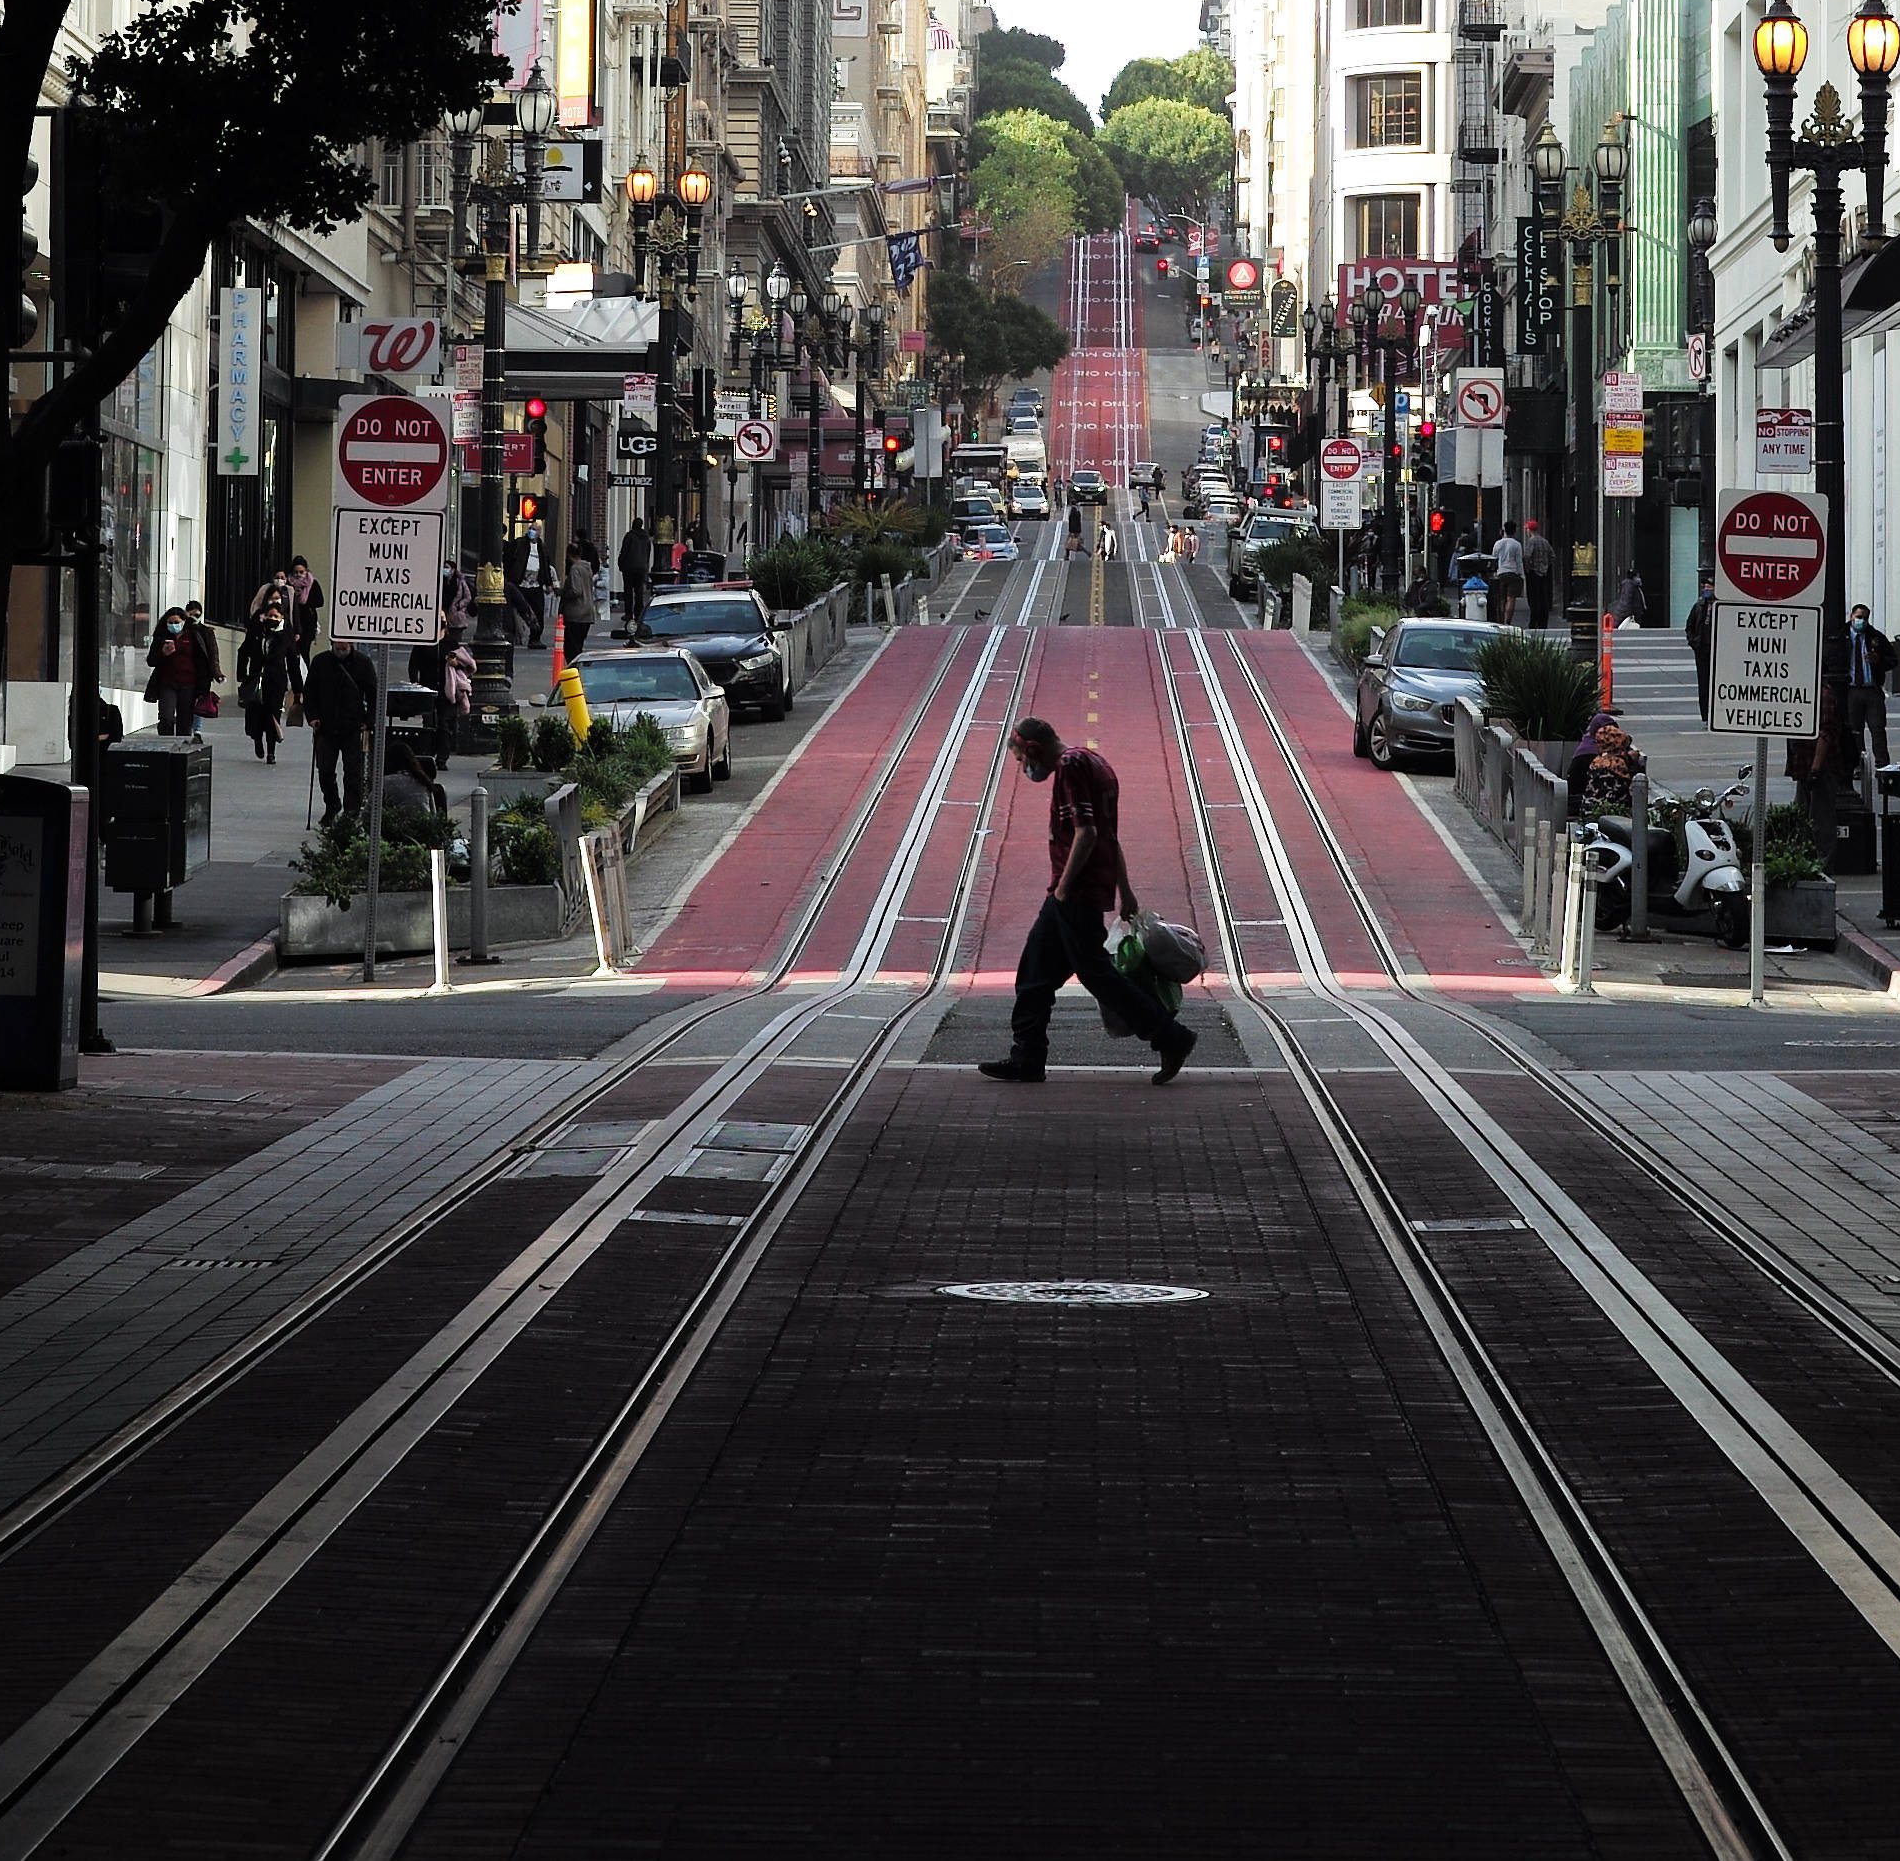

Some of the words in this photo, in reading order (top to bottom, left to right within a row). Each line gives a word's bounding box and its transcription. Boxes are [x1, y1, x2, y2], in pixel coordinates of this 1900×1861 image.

[1483, 282, 1493, 362] COCKTAI
[230, 289, 248, 442] PHARMACY
[356, 418, 382, 436] DO
[395, 419, 433, 437] NOT
[1757, 427, 1775, 437] NO
[1776, 428, 1809, 437] STOPPING
[619, 436, 657, 455] UGG
[1762, 443, 1781, 455] ANY
[1783, 444, 1805, 455] TIME
[361, 467, 422, 486] ENTER
[613, 475, 653, 486] zumiez
[358, 518, 421, 537] EXCEPT
[1735, 512, 1761, 530] DO
[1773, 514, 1810, 532] NOT
[368, 543, 408, 561] MUNI
[365, 567, 411, 585] TAXIS
[1740, 561, 1800, 581] ENTER
[339, 590, 433, 611] COMMERCIAL
[346, 615, 424, 634] VEHICLES
[1737, 611, 1799, 631] EXCEPT
[1747, 636, 1787, 655] MUNI
[1743, 660, 1789, 679] TAXIS
[1718, 683, 1812, 704] COMMERCIAL
[1725, 708, 1803, 728] VEHICLES
